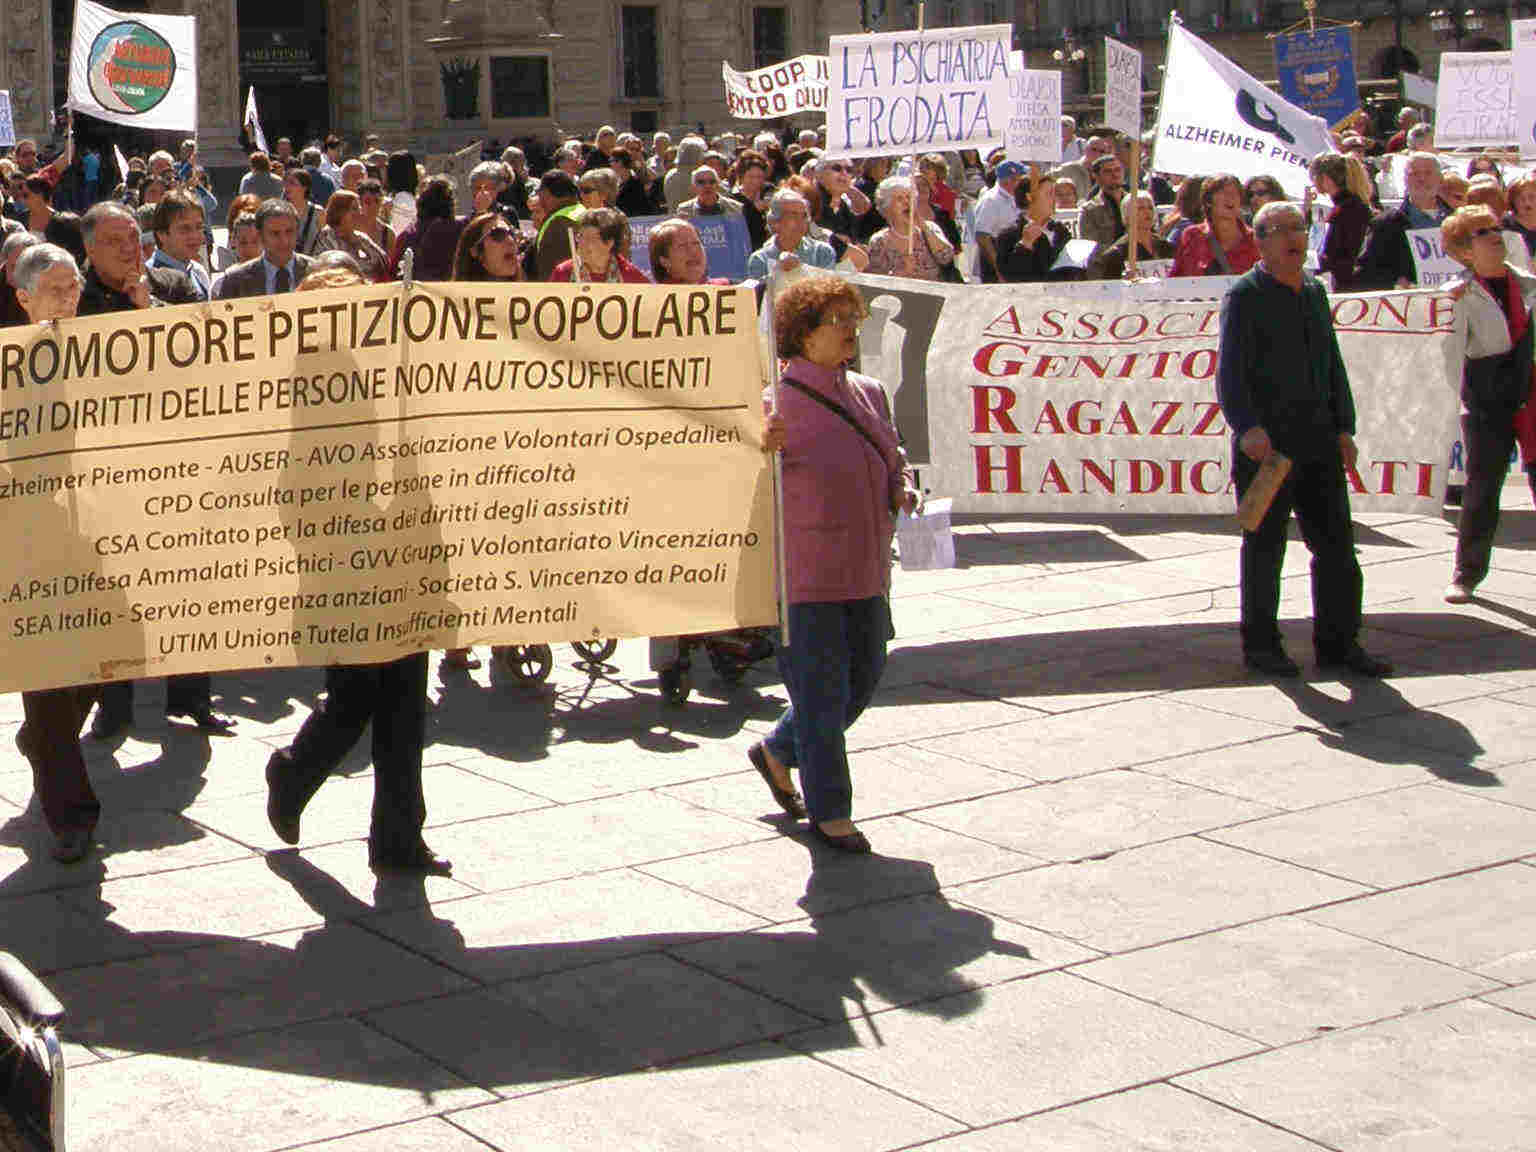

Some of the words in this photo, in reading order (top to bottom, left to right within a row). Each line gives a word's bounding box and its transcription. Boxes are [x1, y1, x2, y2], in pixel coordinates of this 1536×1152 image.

[842, 45, 877, 88] LA
[892, 38, 1008, 86] PSICHIATRIA
[727, 88, 787, 116] ENTRO
[844, 91, 993, 149] FRODATA
[1166, 123, 1264, 153] ALZHEIMER
[269, 294, 497, 358] PETIZIONE
[508, 289, 737, 341] POPOLARE
[972, 341, 1218, 380] GENITO
[37, 405, 43, 434] I
[50, 392, 152, 432] DIRITTI
[161, 382, 250, 421] DELLE
[258, 368, 386, 411] PERSONE
[395, 362, 457, 397] NON
[463, 357, 711, 391] AUTOSUFFICIENTI
[969, 384, 1227, 435] RAGAZZ
[92, 461, 199, 487] Piemonte
[218, 450, 289, 474] AUSER
[307, 444, 356, 467] AVO
[360, 432, 497, 462] Associazione
[503, 427, 611, 451] Volontari
[144, 494, 192, 516] CPD
[199, 485, 294, 511] Consulta
[300, 485, 335, 507] per
[342, 479, 360, 499] le
[365, 473, 443, 503] persone
[449, 468, 469, 488] in
[475, 462, 576, 486] difficoltà
[95, 535, 140, 556] CSA
[146, 525, 250, 552] Comitato
[256, 524, 291, 546] per
[297, 518, 316, 538] la
[323, 514, 386, 536] difesa
[393, 509, 416, 529] dei
[421, 501, 478, 525] diritti
[484, 498, 538, 525] degli
[544, 495, 629, 518] assistiti
[64, 571, 132, 595] Difesa
[137, 559, 247, 587] Ammalati
[254, 552, 334, 577] Psichici
[351, 549, 399, 571] GVV
[402, 539, 465, 565] Gruppi
[470, 534, 612, 557] Volontariato
[618, 529, 759, 550] Vincenziano
[13, 616, 53, 637] SEA
[59, 607, 112, 630] Italia
[130, 598, 202, 623] Servio
[207, 592, 328, 617] emergenza
[332, 581, 408, 605] anziani
[418, 571, 497, 596] Società
[504, 570, 523, 591] S.
[529, 567, 629, 588] Vincenzo
[634, 563, 663, 585] da
[669, 562, 728, 583] Paoli
[159, 632, 218, 655] UTIM
[225, 627, 302, 648] Unione
[306, 622, 369, 644] Tutela
[376, 607, 487, 641] Insufficienti
[492, 601, 578, 626] Mentali
